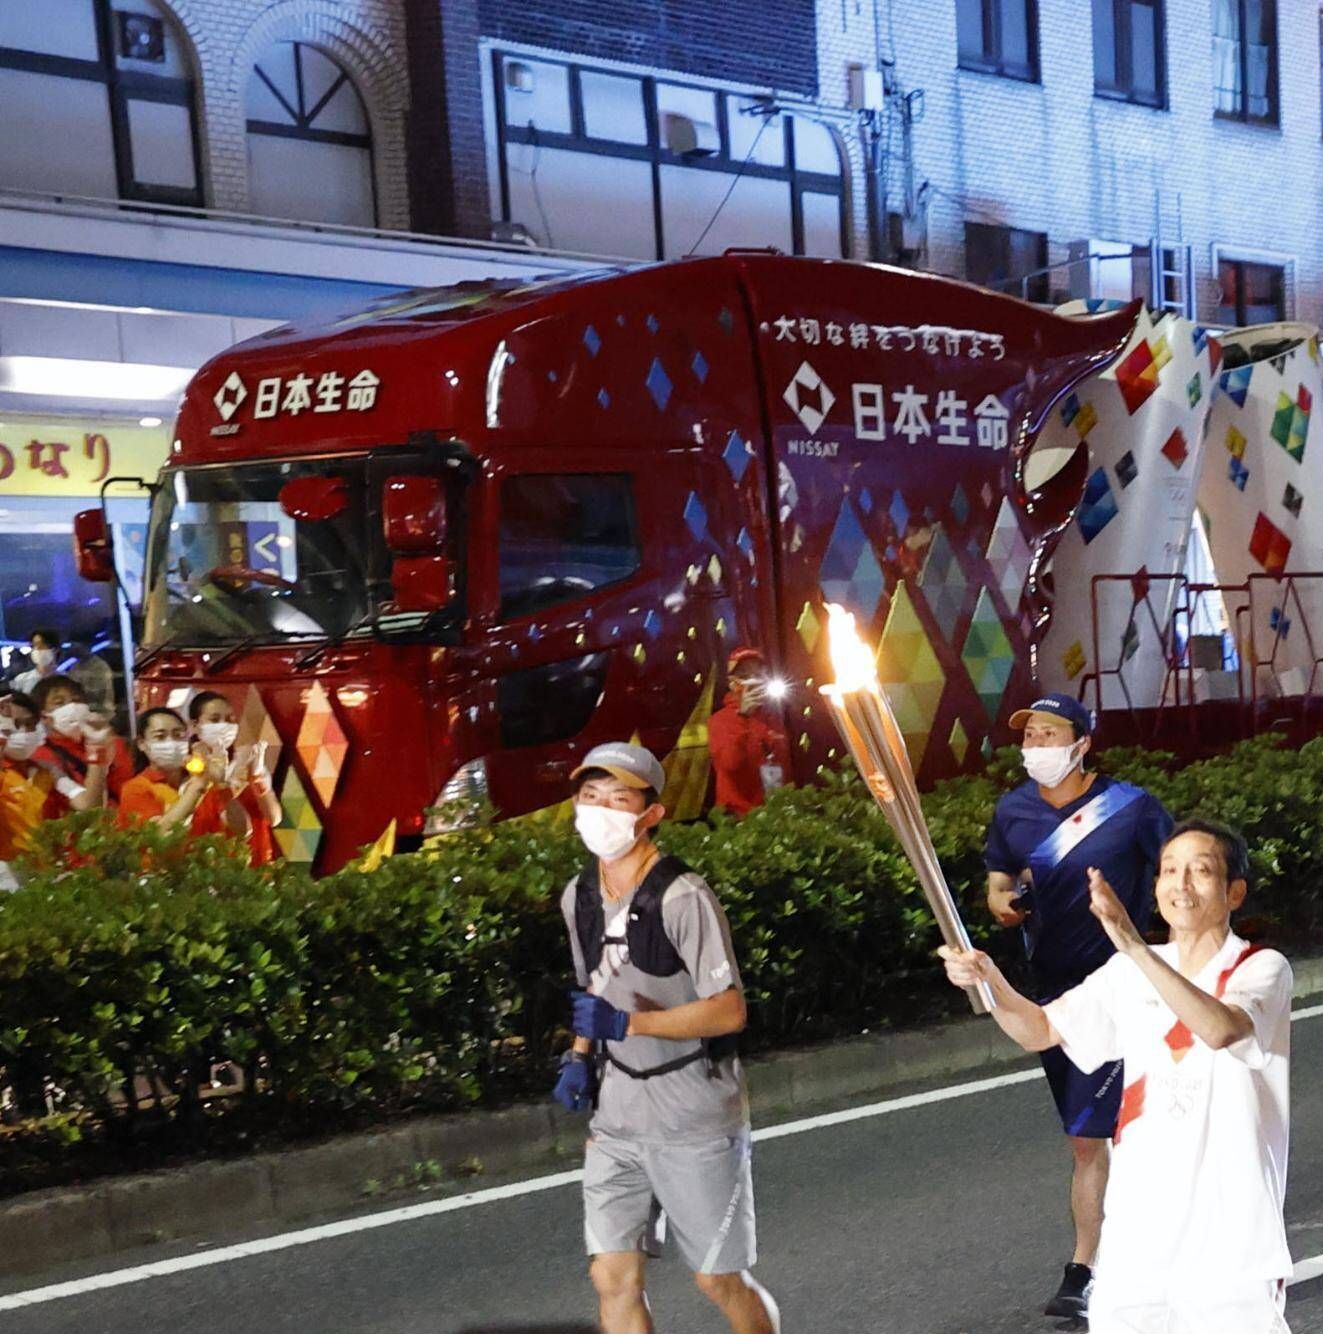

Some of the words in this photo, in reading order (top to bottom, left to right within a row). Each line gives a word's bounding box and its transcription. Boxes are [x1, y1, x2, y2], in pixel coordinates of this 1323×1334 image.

[254, 369, 380, 419] 日本生命
[852, 383, 1010, 450] 日本生命
[787, 440, 840, 457] NISSAY
